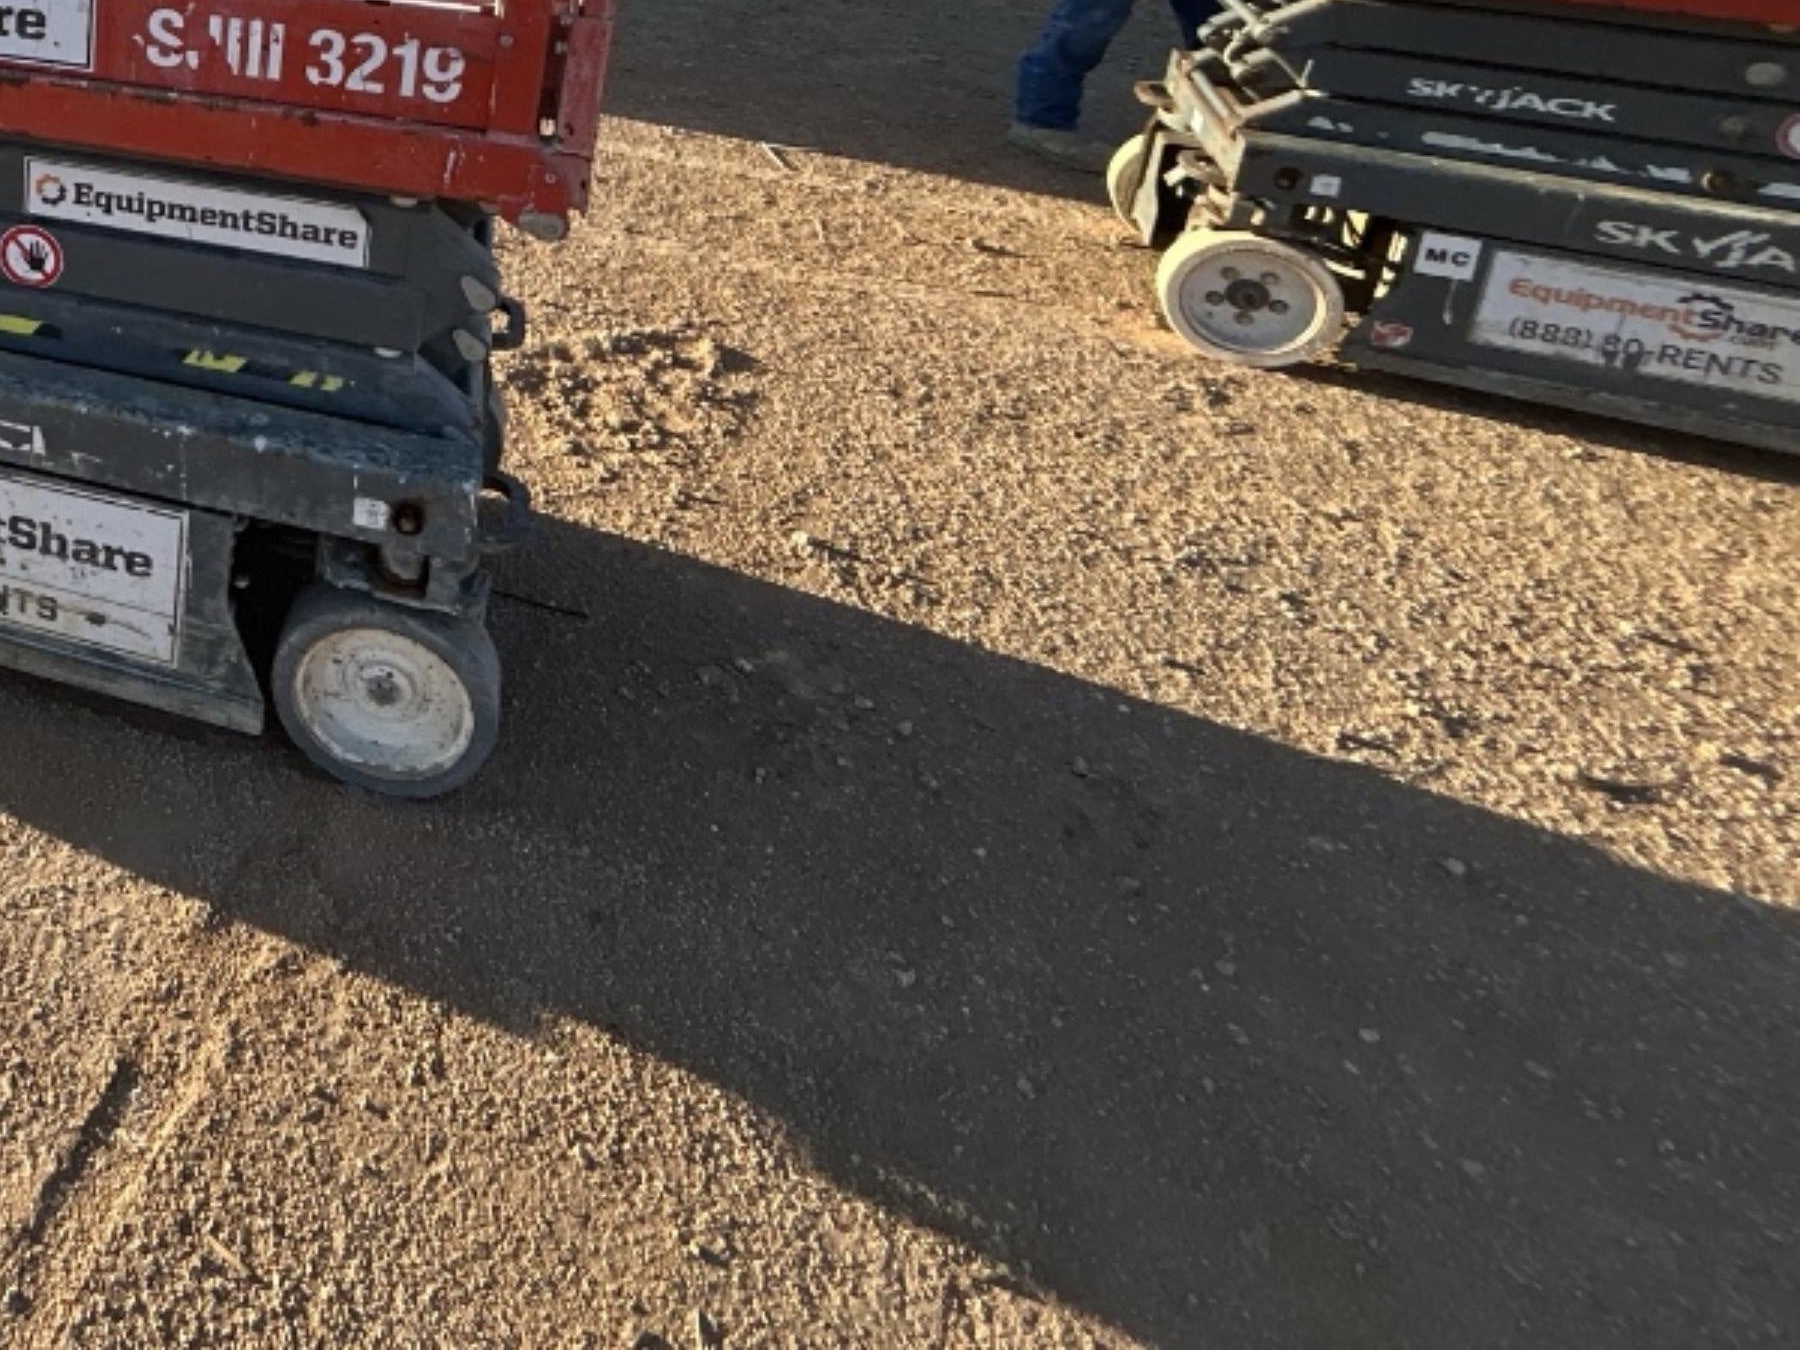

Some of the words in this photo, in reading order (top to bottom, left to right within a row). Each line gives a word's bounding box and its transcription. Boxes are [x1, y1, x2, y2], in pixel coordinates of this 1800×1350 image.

[304, 27, 467, 102] 3219
[72, 181, 360, 249] EquipmentShare
[1424, 247, 1471, 269] MC
